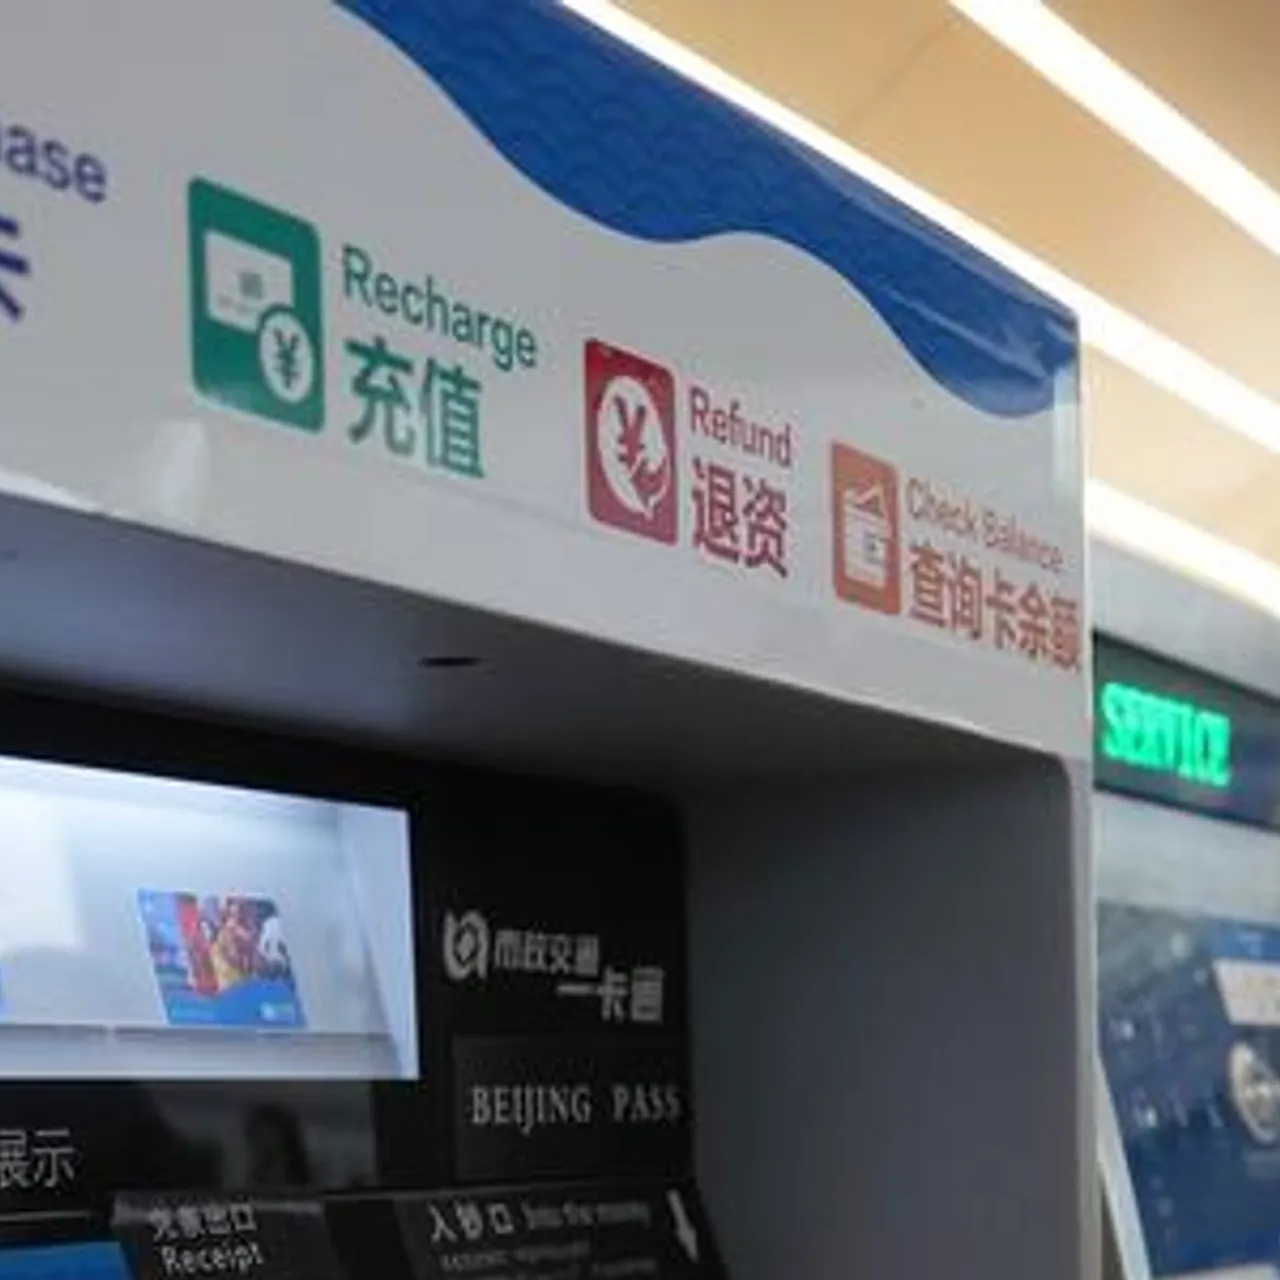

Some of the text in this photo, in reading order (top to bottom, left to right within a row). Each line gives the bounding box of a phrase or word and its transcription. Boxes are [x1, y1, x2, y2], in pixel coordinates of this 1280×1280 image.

[342, 246, 540, 371] Recharge
[346, 334, 484, 478] 充值
[689, 387, 792, 467] Refund
[691, 457, 789, 578] 退资
[1101, 682, 1231, 787] SERVICE
[471, 1084, 681, 1134] BEIJING PASS
[161, 1241, 263, 1276] Receipt
